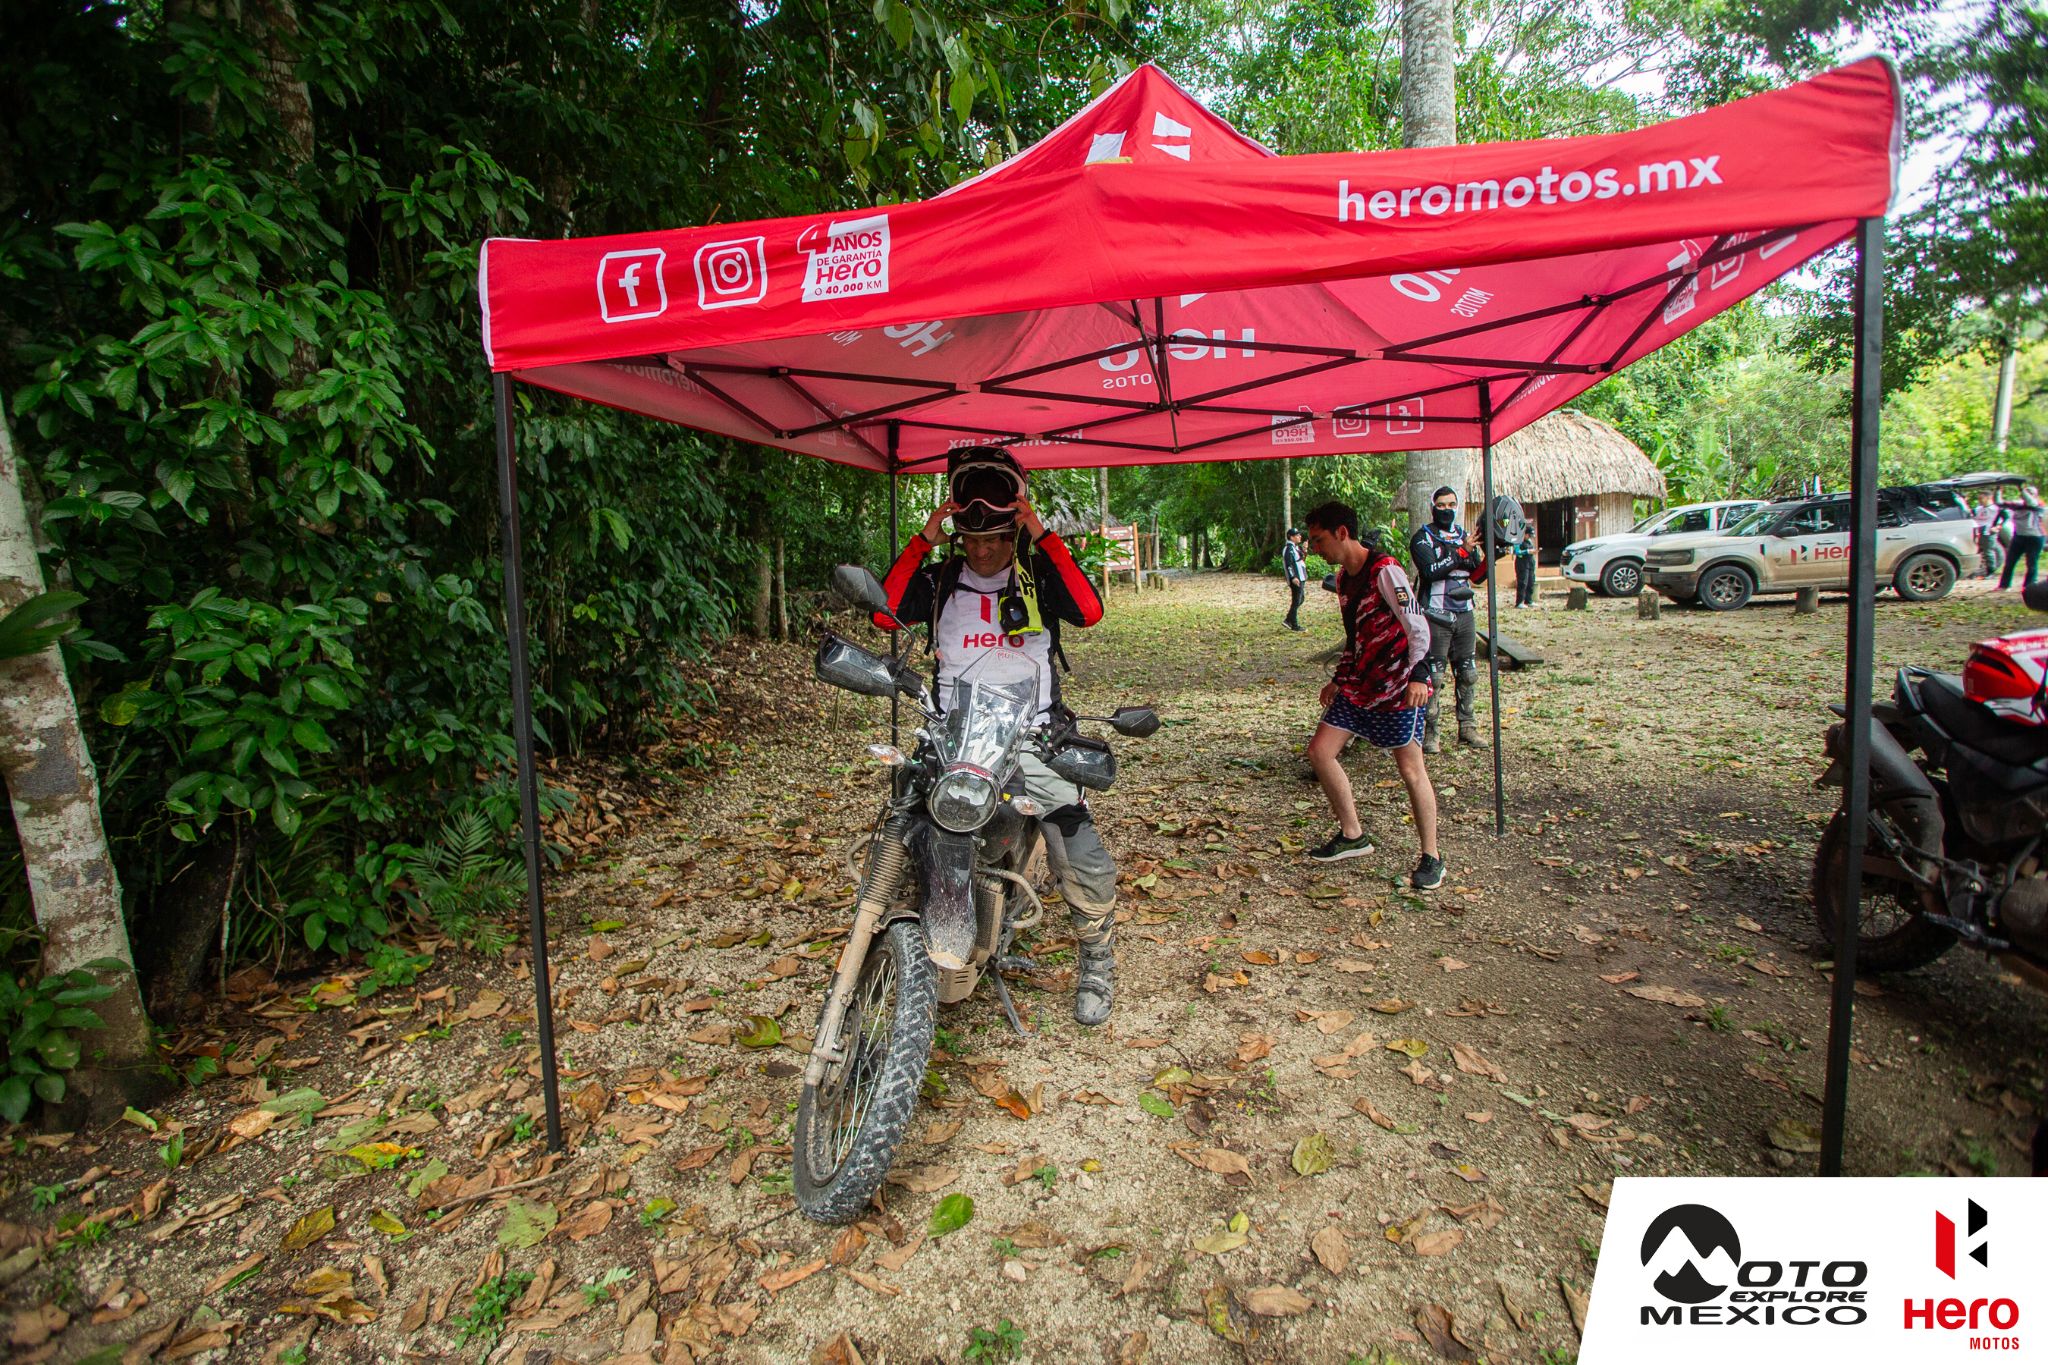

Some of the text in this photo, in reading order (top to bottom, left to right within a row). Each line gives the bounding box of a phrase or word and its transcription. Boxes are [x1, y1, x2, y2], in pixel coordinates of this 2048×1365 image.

[1338, 155, 1723, 222] heromotos.mx
[832, 231, 882, 253] AÑOS
[816, 249, 882, 267] DE GARANTÍA
[816, 258, 881, 285] Hero
[825, 282, 863, 294] 40,000
[866, 280, 882, 290] KM
[1815, 546, 1851, 560] Her
[963, 632, 1025, 648] Hero
